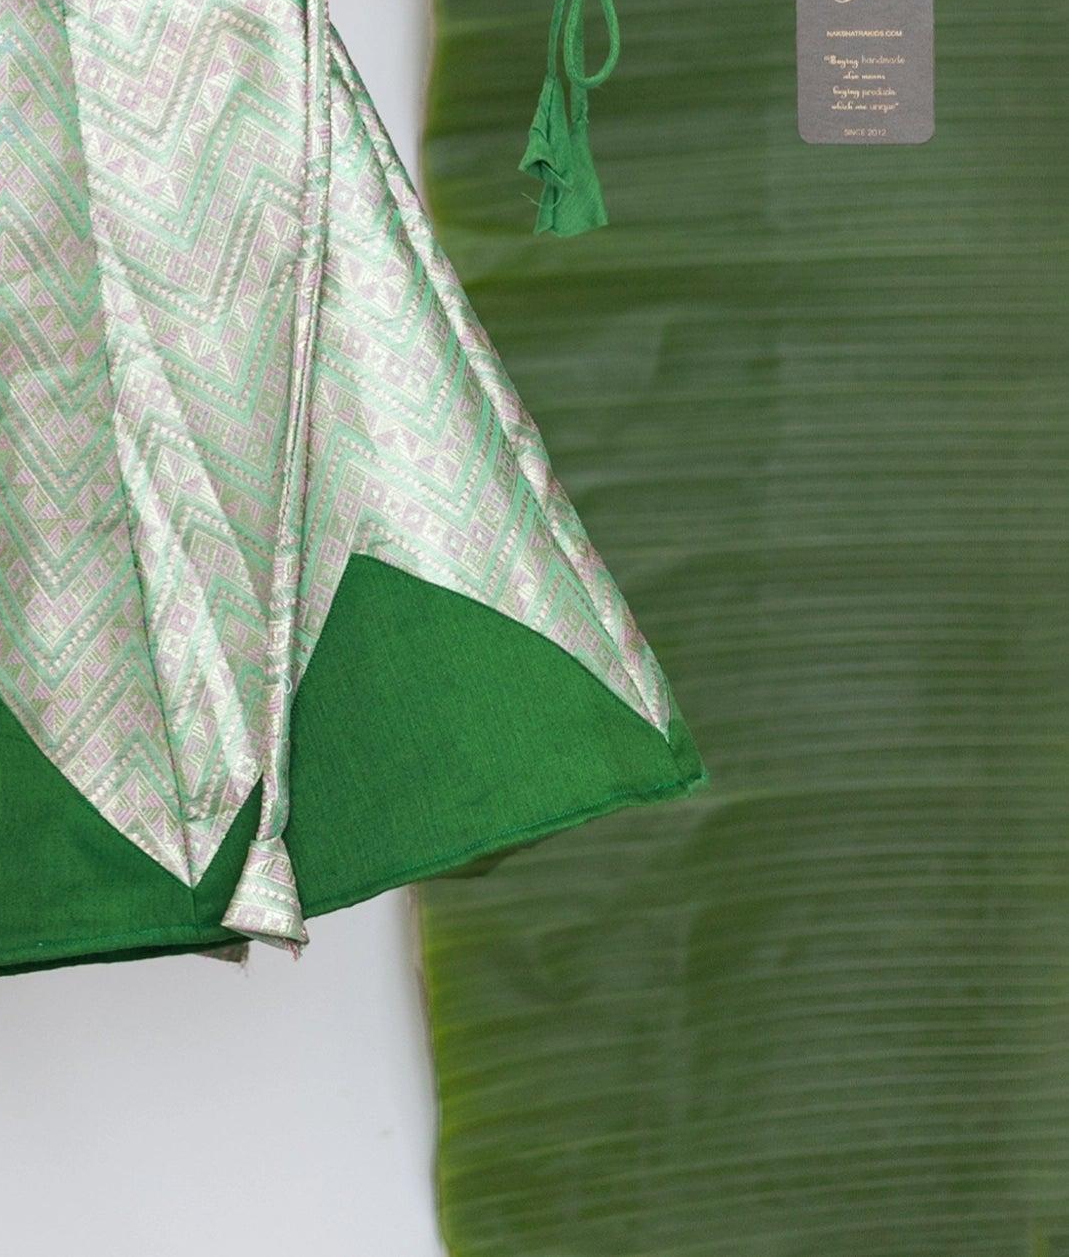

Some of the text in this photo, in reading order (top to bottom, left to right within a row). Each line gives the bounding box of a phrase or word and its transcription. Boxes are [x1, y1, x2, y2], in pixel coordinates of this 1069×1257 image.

[826, 30, 903, 38] NAKSHATRAKIDS.COM
[861, 55, 905, 64] handmade
[843, 71, 859, 80] also
[832, 85, 896, 99] buying products
[831, 102, 853, 111] which
